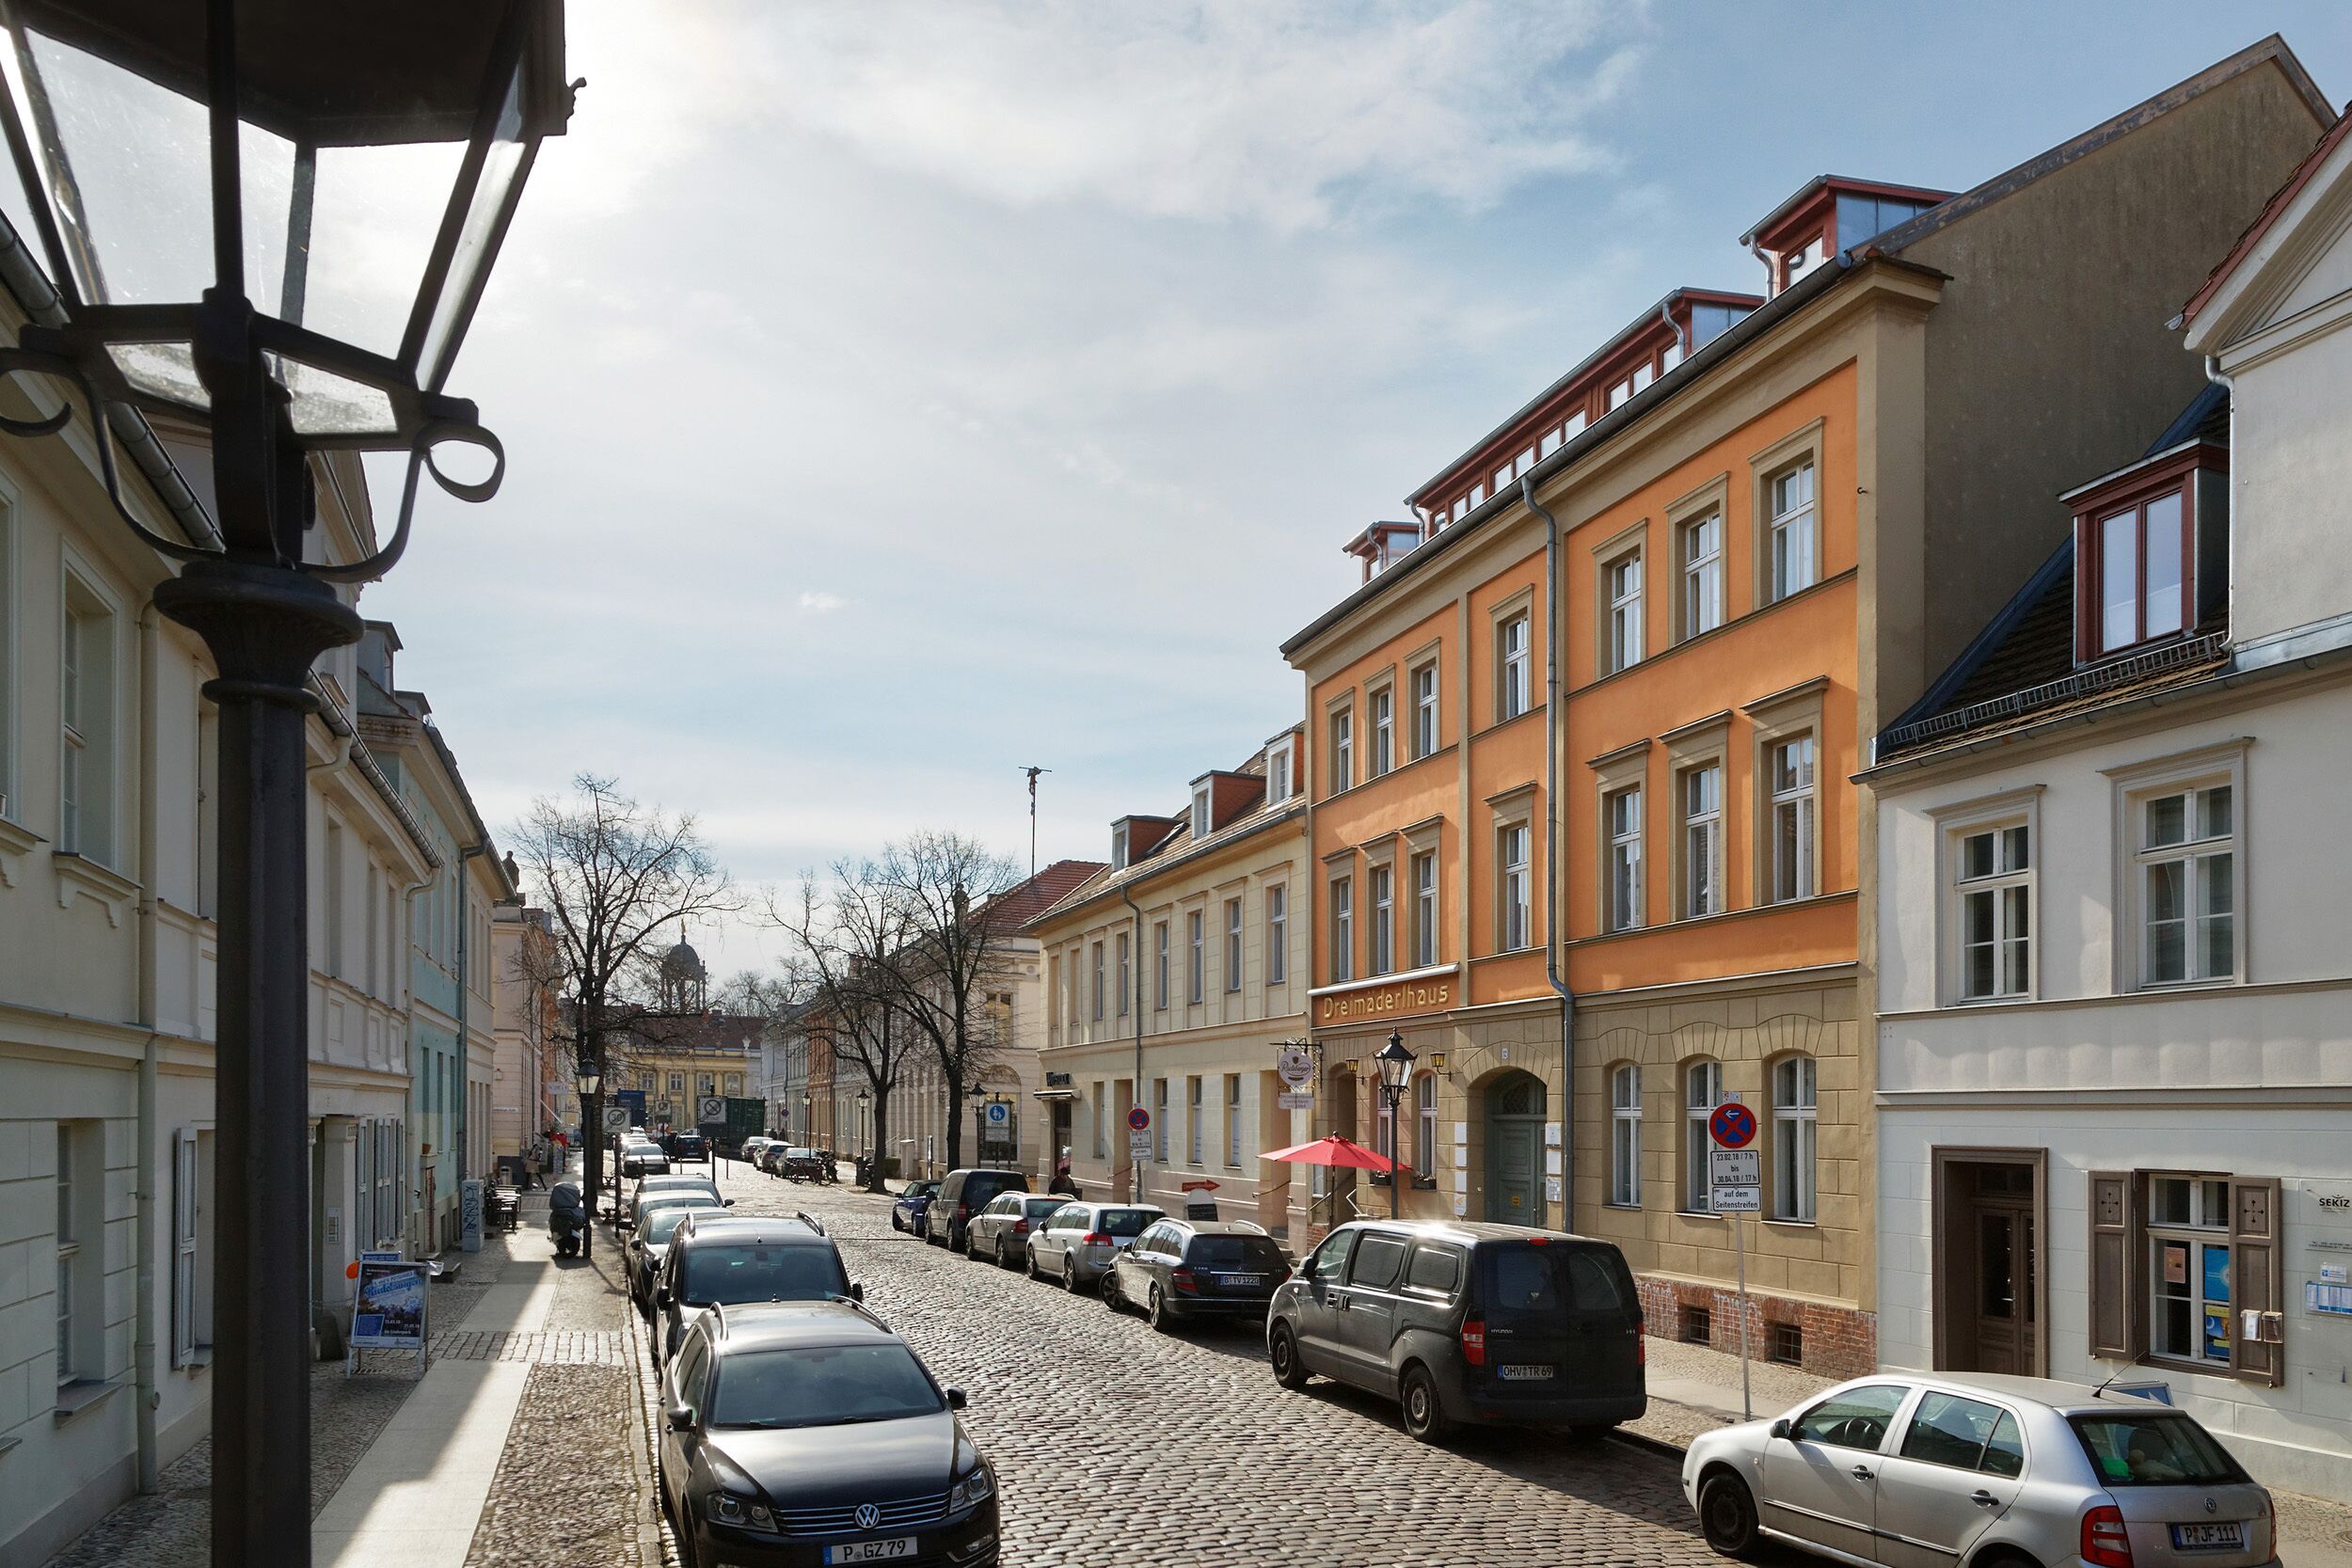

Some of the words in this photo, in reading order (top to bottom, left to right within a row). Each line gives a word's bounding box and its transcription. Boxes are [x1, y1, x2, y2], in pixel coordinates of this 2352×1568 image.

[1324, 983, 1449, 1019] Dreimäderlhaus
[612, 1113, 622, 1121] 30
[1745, 1174, 1752, 1182] 17
[2318, 1197, 2350, 1208] SEKIZ
[1503, 1366, 1521, 1376] OHV
[1529, 1366, 1540, 1376] TR
[1541, 1366, 1552, 1376] 69
[855, 1504, 880, 1528] VW
[2185, 1527, 2193, 1543] P
[2201, 1526, 2214, 1542] JF
[2217, 1525, 2238, 1542] 111
[843, 1545, 853, 1561] P
[864, 1542, 884, 1559] GZ
[887, 1540, 906, 1556] 79
